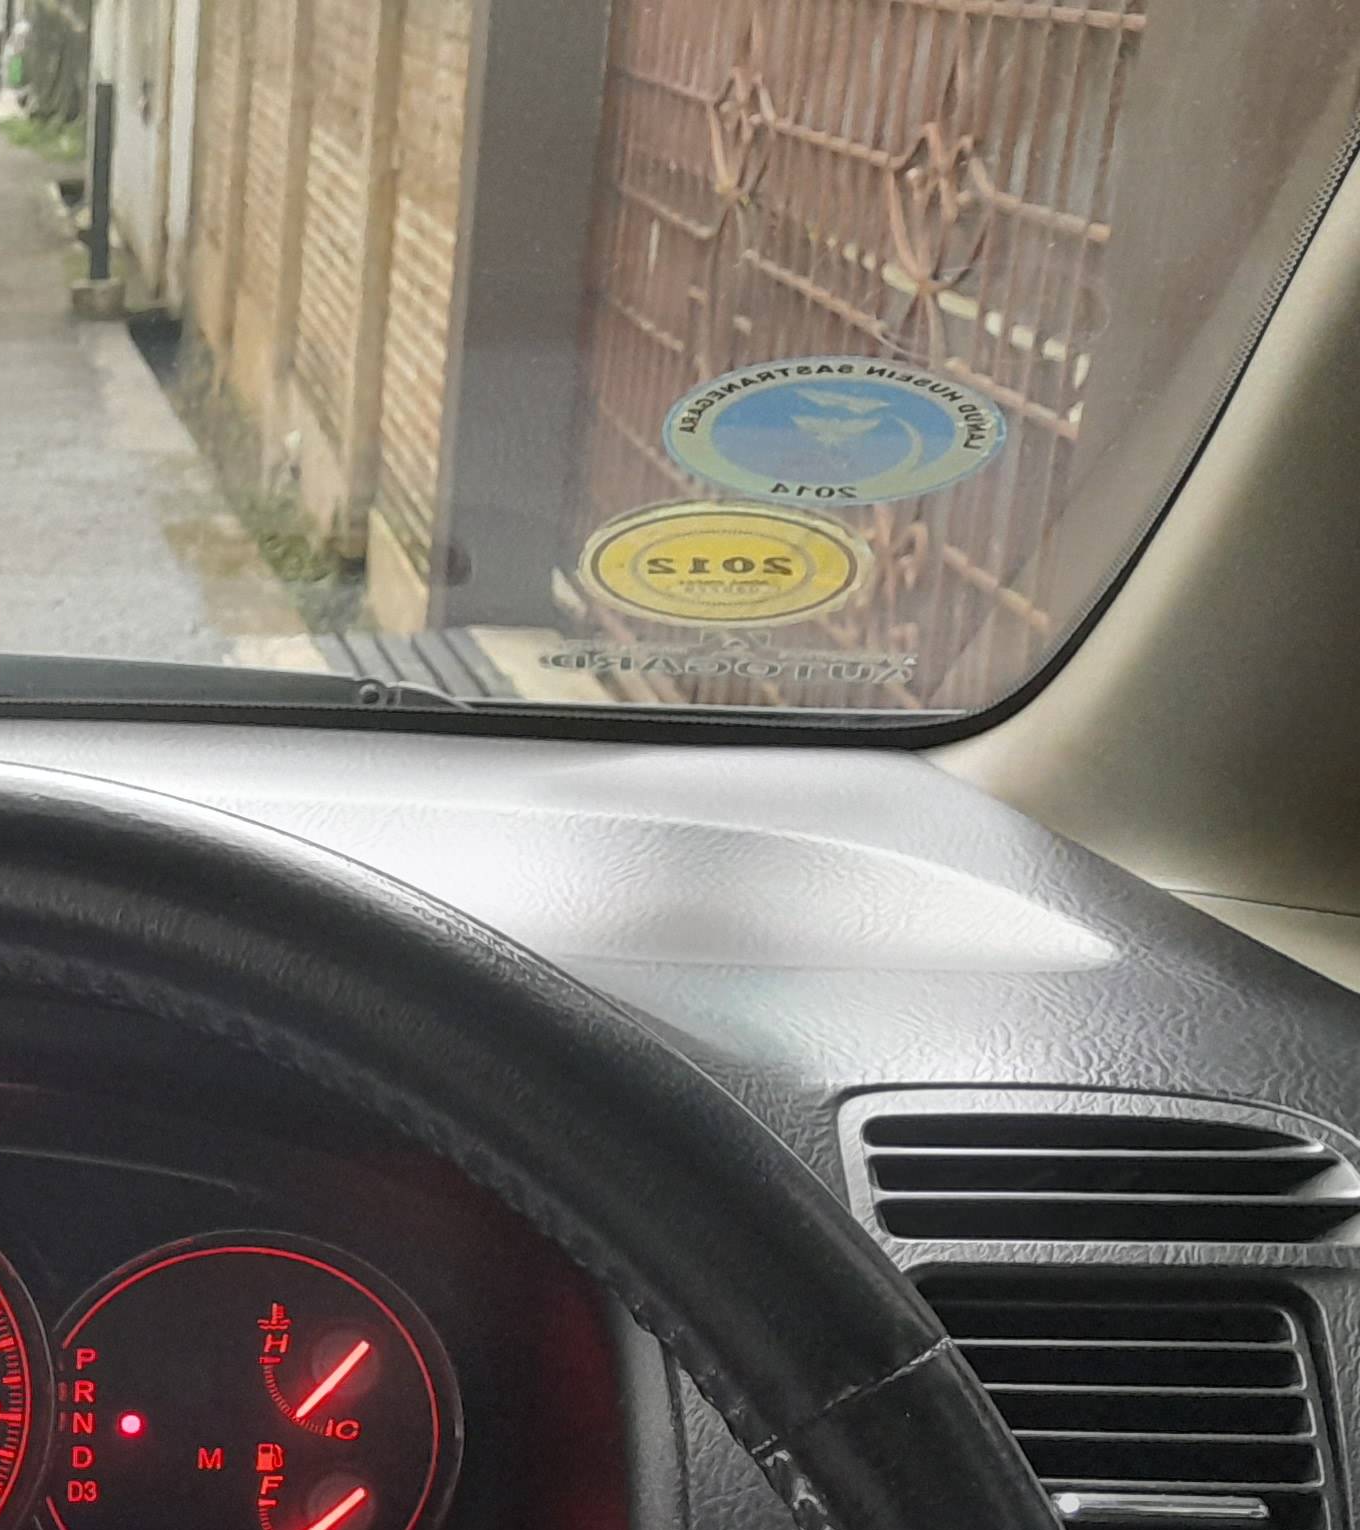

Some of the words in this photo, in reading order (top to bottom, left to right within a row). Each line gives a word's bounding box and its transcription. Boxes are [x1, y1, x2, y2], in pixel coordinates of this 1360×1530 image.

[262, 1333, 290, 1353] H
[74, 1348, 97, 1370] P
[73, 1380, 96, 1403] R
[71, 1412, 95, 1434] N
[335, 1419, 361, 1441] C
[71, 1446, 94, 1469] D
[196, 1447, 225, 1470] M
[67, 1481, 98, 1503] D3
[259, 1475, 284, 1495] F
